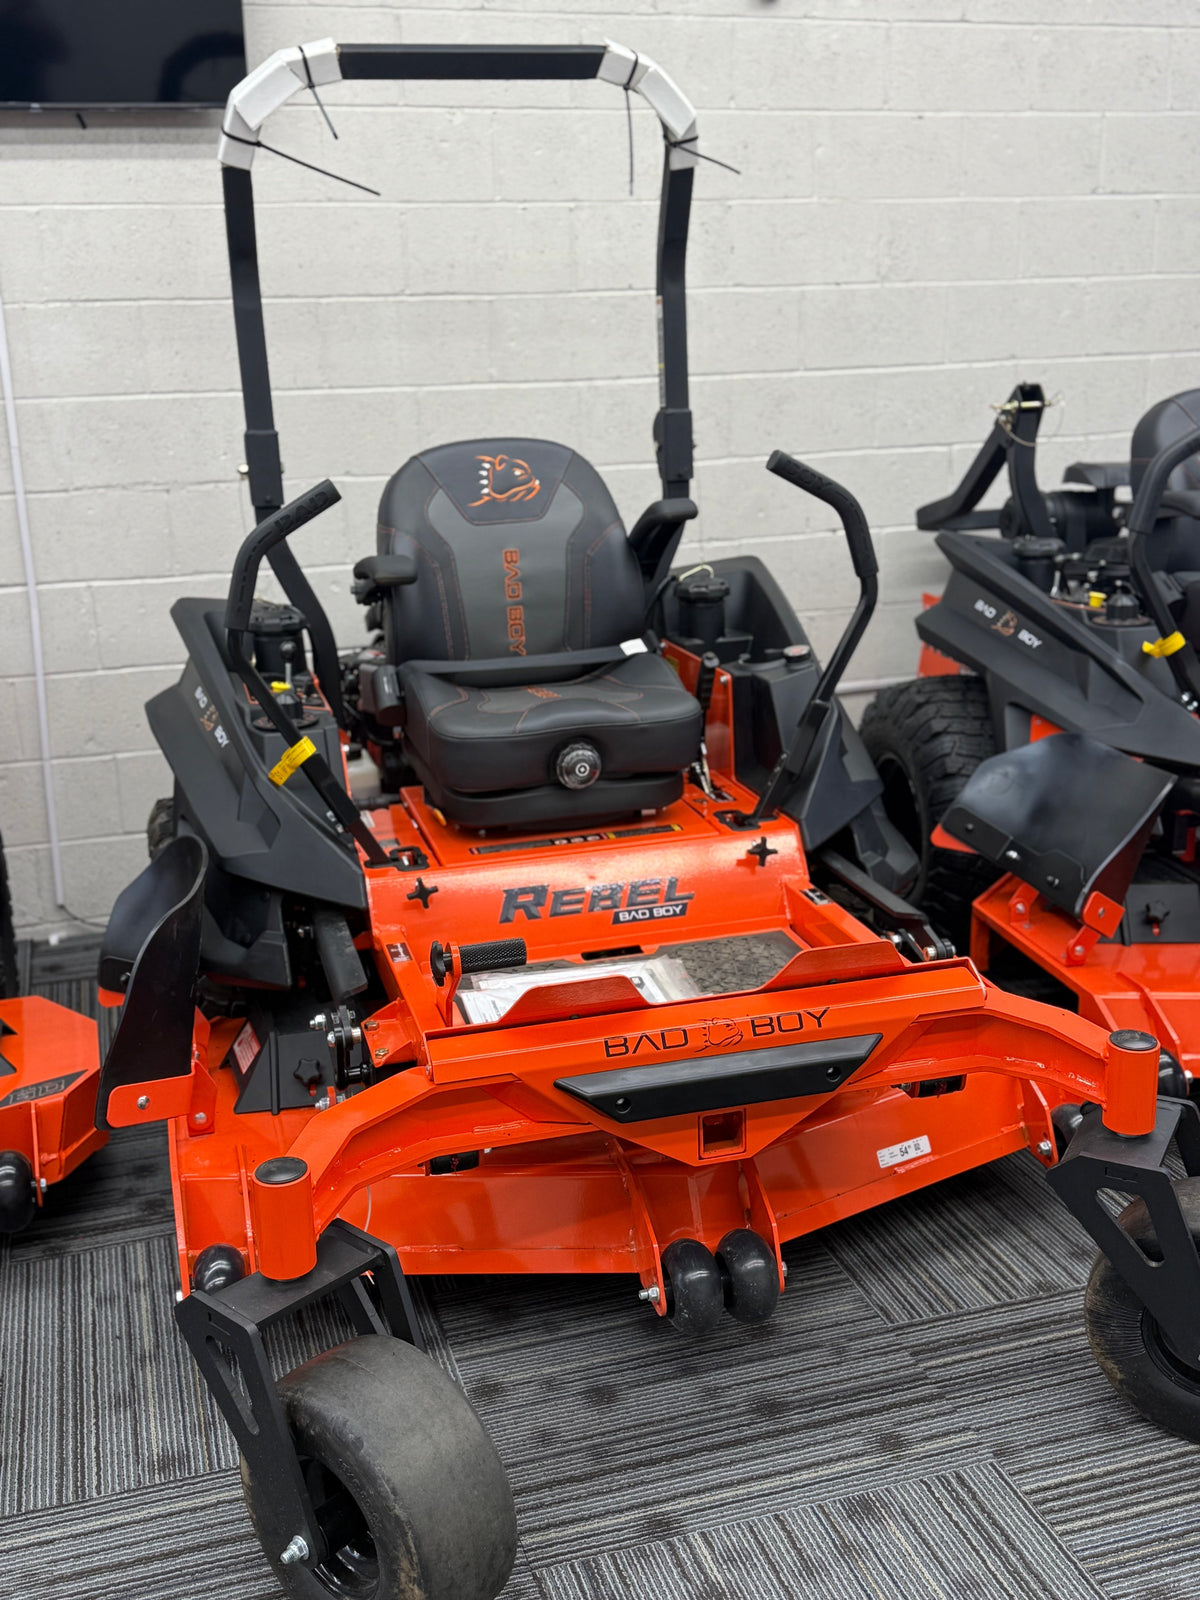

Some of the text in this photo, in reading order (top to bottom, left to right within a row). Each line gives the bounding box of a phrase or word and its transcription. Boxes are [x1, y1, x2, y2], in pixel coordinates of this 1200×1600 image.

[274, 491, 329, 535] BAD
[502, 549, 527, 656] BAD BOY
[1017, 628, 1042, 648] BOY
[499, 876, 695, 924] REBEL
[619, 904, 683, 922] BAD BOY
[603, 1006, 831, 1058] BAD BOY
